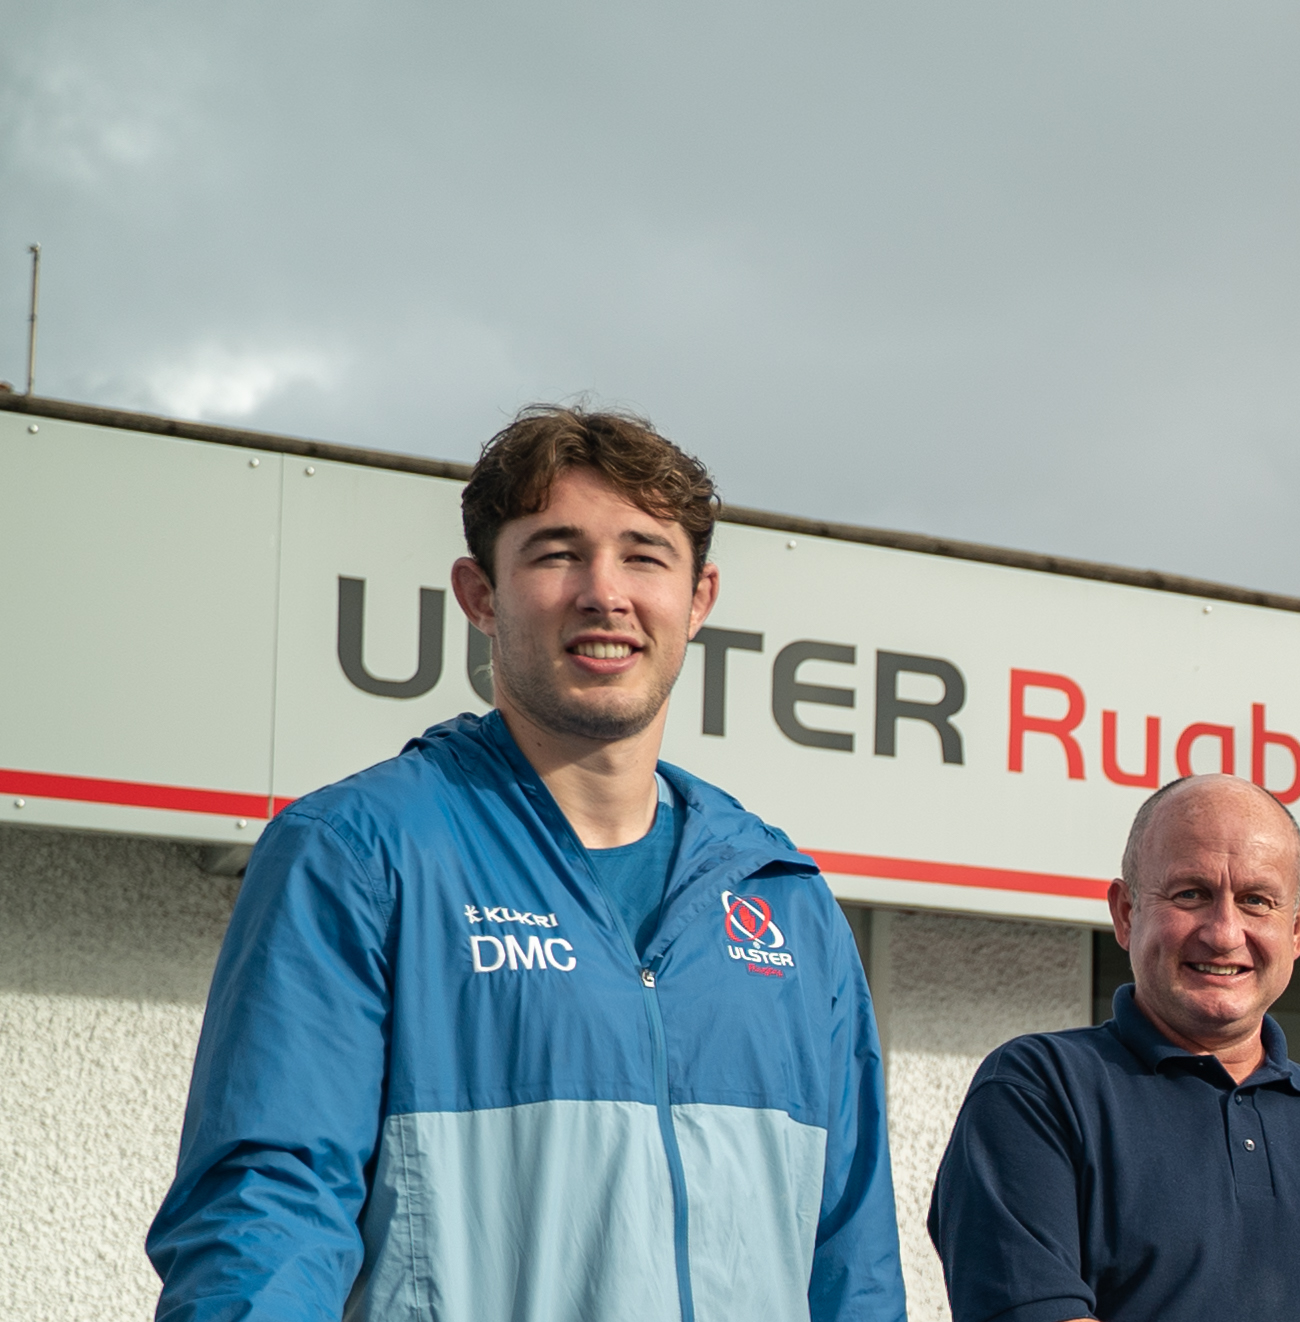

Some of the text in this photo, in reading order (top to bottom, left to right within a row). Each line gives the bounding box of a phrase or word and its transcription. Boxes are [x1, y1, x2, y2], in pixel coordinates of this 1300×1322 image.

[337, 574, 967, 766] UTER
[484, 906, 559, 928] KUKRI
[470, 935, 577, 973] DMC
[727, 945, 795, 967] ULSTER
